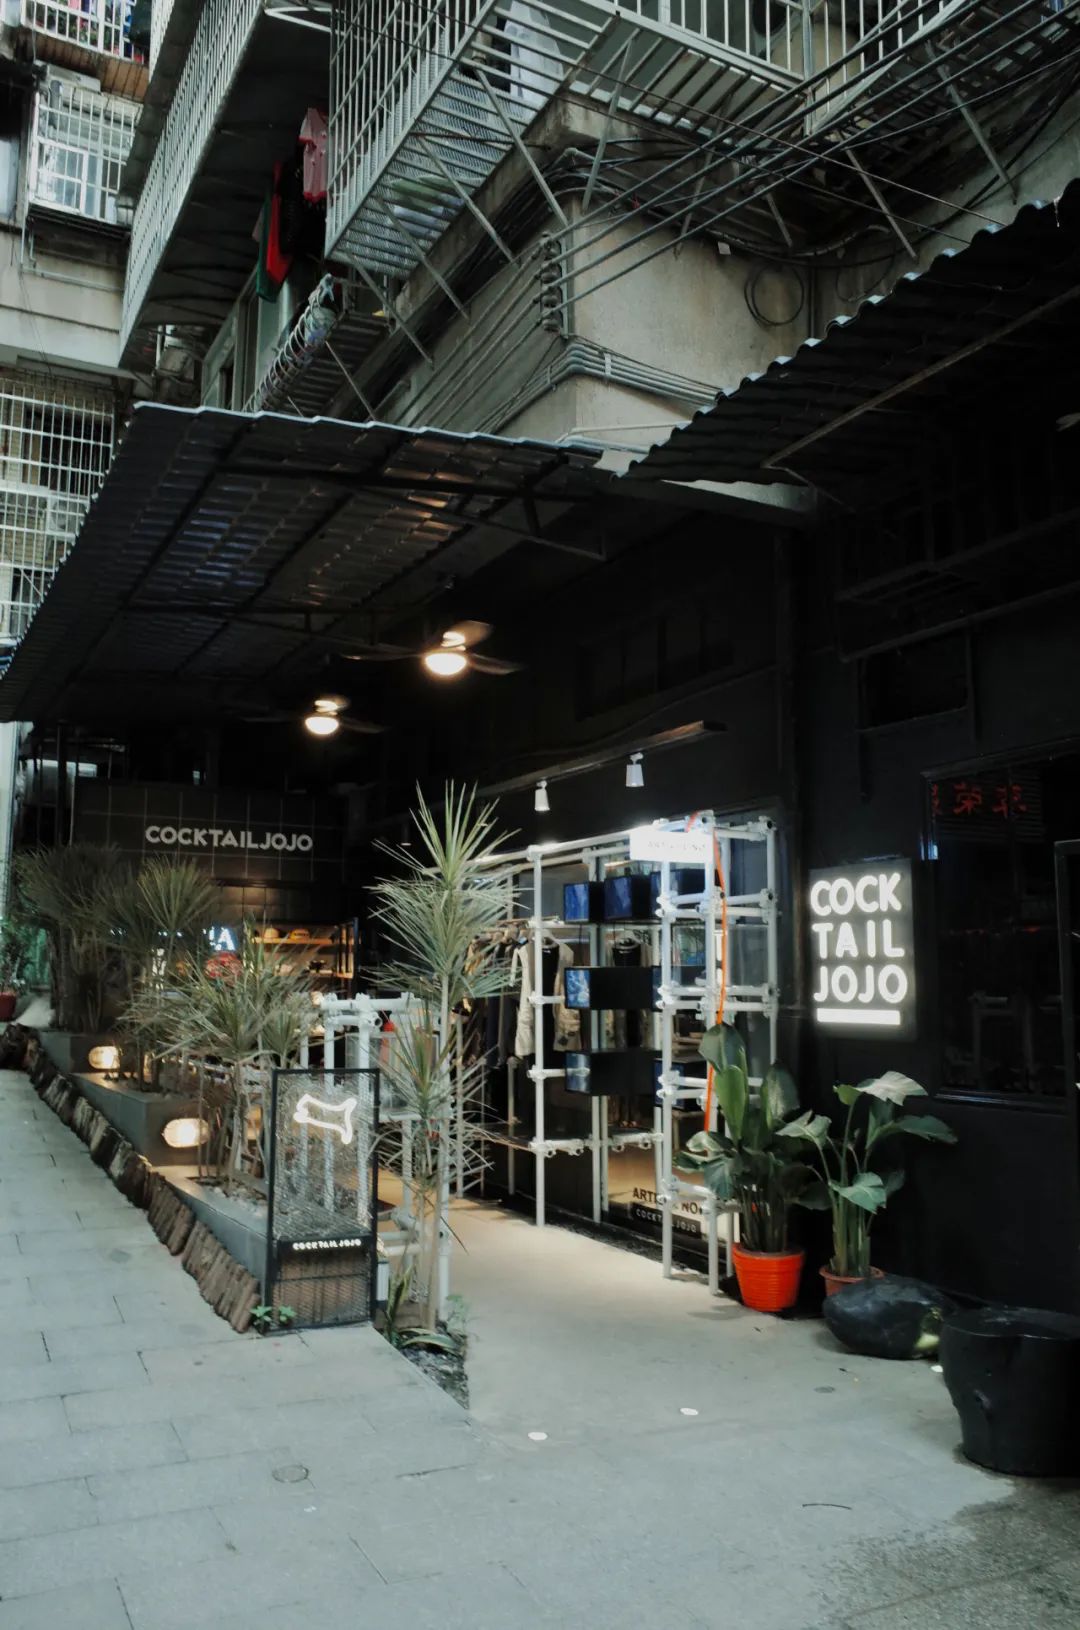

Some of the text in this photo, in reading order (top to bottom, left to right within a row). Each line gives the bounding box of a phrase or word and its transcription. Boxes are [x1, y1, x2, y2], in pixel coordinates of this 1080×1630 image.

[810, 872, 902, 917] COCK
[811, 919, 905, 959] TAIL
[813, 964, 908, 1004] JOJO
[339, 1238, 362, 1248] JOJO
